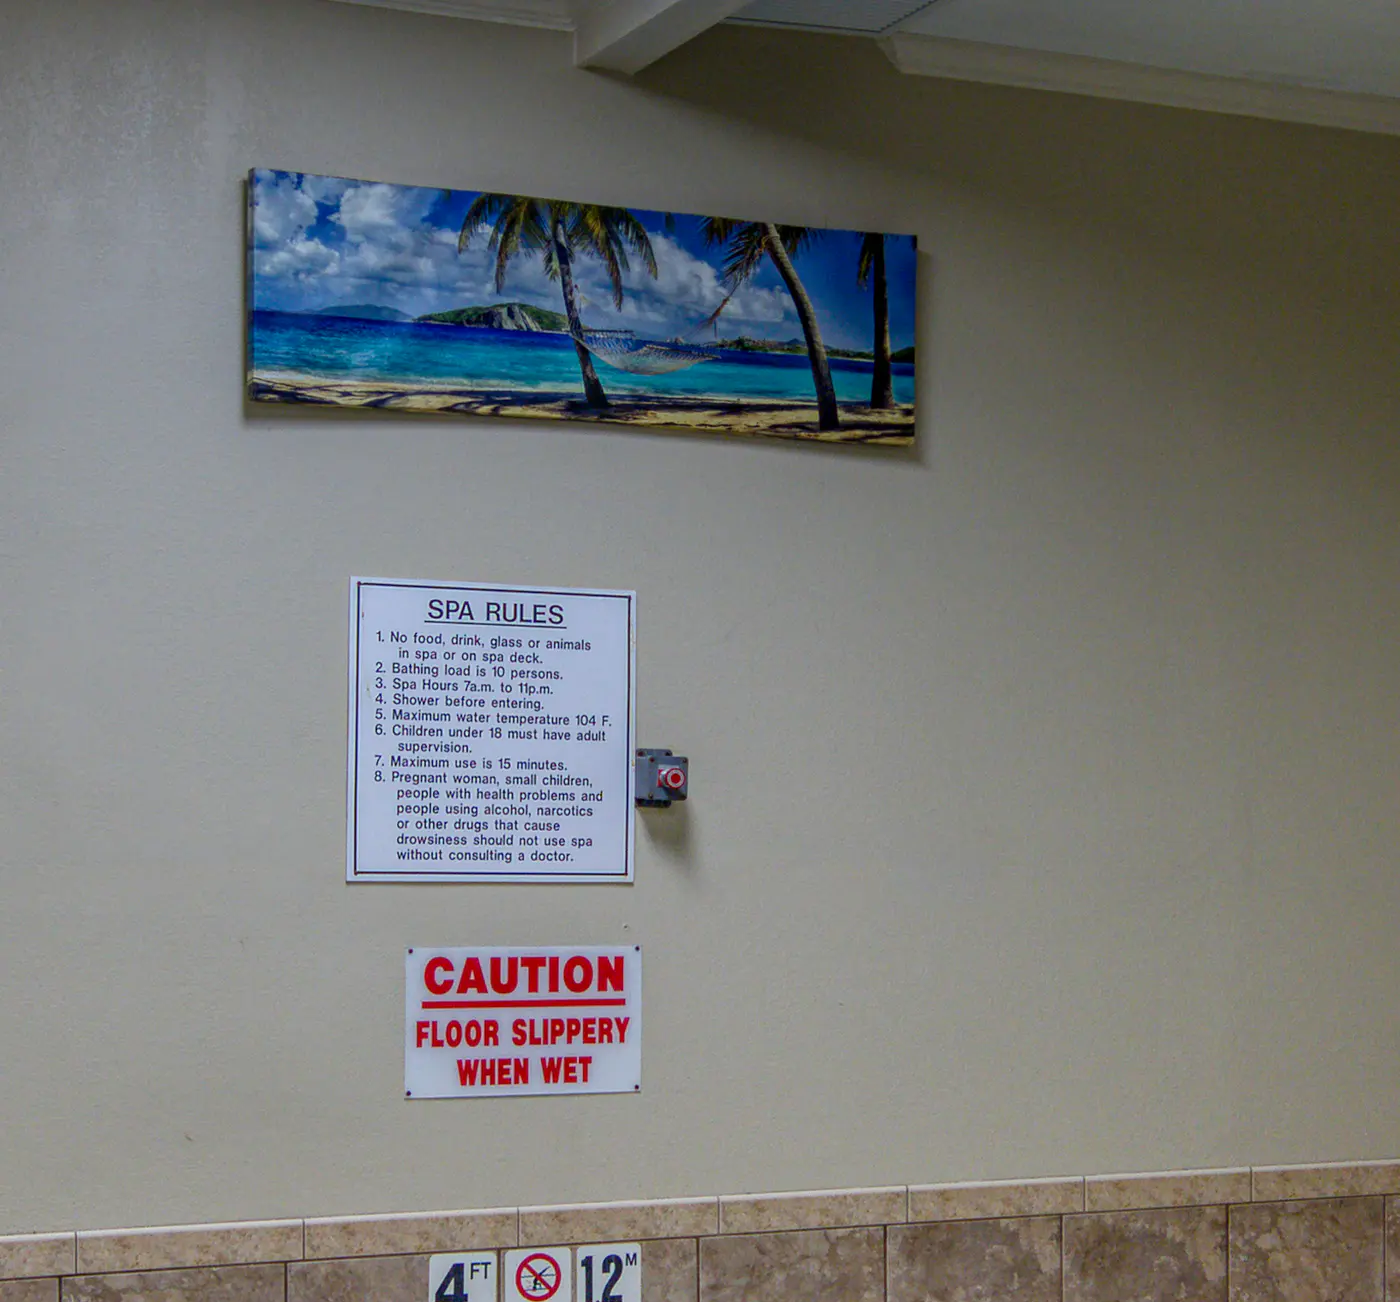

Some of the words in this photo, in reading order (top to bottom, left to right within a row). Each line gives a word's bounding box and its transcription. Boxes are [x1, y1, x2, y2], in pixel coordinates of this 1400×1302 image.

[428, 599, 474, 620] SPA
[486, 602, 563, 625] RULES
[376, 630, 385, 642] 1.
[390, 631, 408, 643] No
[413, 632, 445, 646] food,
[451, 634, 484, 648] drink,
[490, 636, 522, 649] glass
[528, 639, 540, 648] or
[546, 638, 591, 651] animals
[399, 647, 409, 658] in
[415, 650, 437, 661] spa
[443, 651, 456, 660] or
[461, 652, 476, 661] on
[482, 653, 504, 664] spa
[510, 652, 543, 664] deck.
[375, 661, 386, 673] 2.
[392, 662, 439, 678] Bathing
[445, 664, 470, 676] load
[476, 665, 486, 677] is
[492, 666, 505, 678] 10
[511, 669, 563, 680] persons.
[375, 677, 386, 689] 3.
[392, 677, 416, 692] Spa
[422, 679, 458, 691] Hours
[464, 680, 494, 692] 7a.m.
[500, 682, 512, 693] to
[518, 682, 553, 696] 11p.m.
[375, 693, 387, 704] 4.
[393, 693, 439, 706] Shower
[445, 695, 485, 708] before
[491, 697, 544, 712] entering.
[375, 708, 386, 720] 5.
[392, 709, 451, 722] Maximum
[456, 712, 491, 723] water
[496, 713, 570, 726] temperature
[575, 714, 596, 726] 104
[602, 715, 612, 727] F.
[375, 723, 386, 736] 6.
[392, 724, 443, 737] Children
[448, 726, 483, 738] under
[489, 727, 502, 739] 18
[508, 729, 538, 740] must
[543, 729, 571, 741] have
[576, 730, 606, 741] adult
[398, 741, 472, 754] supervision.
[374, 754, 384, 766] 7.
[391, 755, 449, 768] Maximum
[455, 760, 477, 769] use
[482, 757, 492, 769] is
[498, 758, 511, 769] 15
[517, 758, 567, 771] minutes.
[374, 770, 386, 782] 8.
[392, 771, 447, 785] Pregnant
[453, 775, 499, 786] woman,
[505, 774, 537, 785] small
[542, 774, 592, 788] children,
[397, 787, 440, 801] people
[445, 788, 471, 799] with
[476, 788, 514, 800] health
[520, 789, 575, 802] problems
[581, 790, 603, 802] and
[396, 802, 440, 816] people
[445, 803, 478, 817] using
[484, 804, 531, 817] alcohol,
[537, 805, 593, 817] narcotics
[397, 820, 409, 829] or
[415, 818, 448, 830] other
[454, 818, 488, 833] drugs
[494, 819, 518, 830] that
[524, 822, 560, 831] cause
[396, 833, 467, 845] drowsiness
[473, 834, 514, 846] should
[519, 836, 538, 846] not
[544, 837, 566, 846] use
[571, 838, 593, 849] spa
[396, 849, 443, 860] without
[448, 849, 512, 864] consulting
[518, 852, 525, 861] a
[530, 850, 574, 862] doctor.
[423, 955, 625, 995] CAUTION
[415, 1019, 499, 1048] FLOOR
[511, 1016, 631, 1046] SLIPPERY
[456, 1057, 530, 1087] WHEN
[540, 1055, 592, 1084] WET
[625, 1252, 637, 1267] M
[469, 1261, 492, 1280] FT
